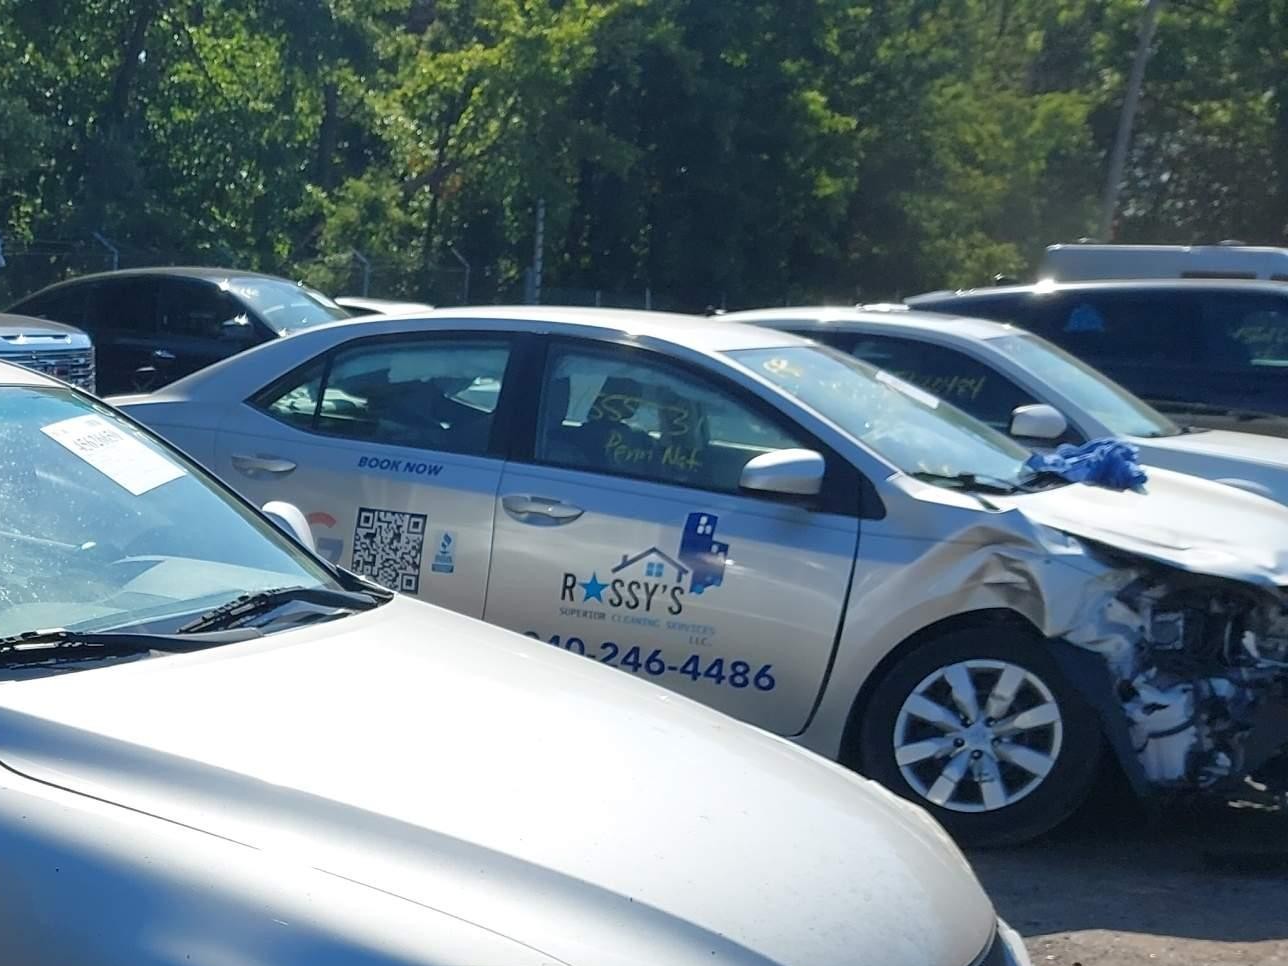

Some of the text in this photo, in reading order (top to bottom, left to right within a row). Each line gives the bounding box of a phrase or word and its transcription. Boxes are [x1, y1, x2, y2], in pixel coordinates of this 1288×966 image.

[358, 456, 444, 476] BOOK NOW
[560, 606, 607, 621] SUPERIOR
[524, 631, 776, 692] 0-246-4486
